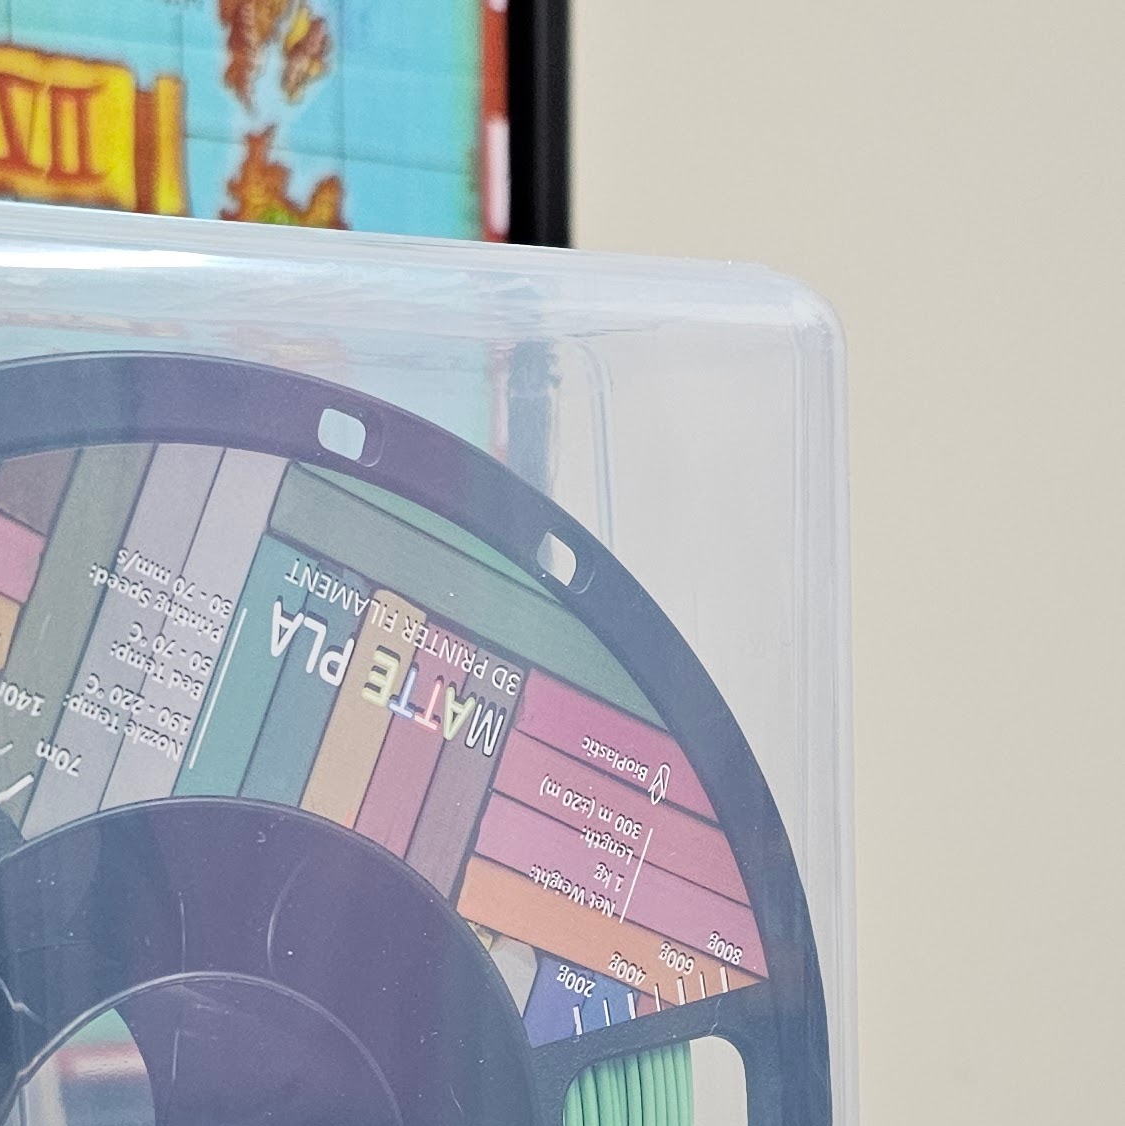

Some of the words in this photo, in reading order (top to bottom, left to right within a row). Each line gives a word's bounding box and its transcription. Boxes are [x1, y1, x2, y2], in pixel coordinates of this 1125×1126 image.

[116, 548, 171, 586] mm/s
[88, 563, 153, 609] Speed:
[172, 576, 196, 602] 70
[284, 558, 399, 633] FILAMENT
[153, 591, 224, 643] Printing
[208, 594, 233, 619] 30
[128, 622, 148, 648] °C
[152, 634, 176, 658] 70
[270, 596, 356, 687] PLA
[401, 616, 489, 680] PRINTER
[109, 641, 165, 683] Temp:
[189, 651, 213, 675] 50
[85, 673, 105, 699] °C
[168, 670, 204, 701] Bed
[491, 664, 521, 696] 3D
[62, 692, 120, 735] Temp:
[109, 685, 145, 715] 220
[361, 646, 505, 757] MATTE
[157, 707, 192, 736] 190
[36, 738, 82, 777] 70m
[123, 721, 183, 763] Nozzle
[581, 736, 649, 782] BioPlastic
[539, 773, 562, 799] m)
[598, 804, 613, 823] m
[614, 813, 643, 840] 300
[580, 825, 634, 865] Length:
[528, 864, 586, 905] Weight:
[593, 863, 612, 889] kg
[614, 875, 624, 892] 1
[589, 891, 616, 918] Net
[658, 941, 694, 975] 600g
[706, 932, 742, 965] 800g
[556, 964, 596, 998] 200g
[607, 952, 646, 986] 400g
